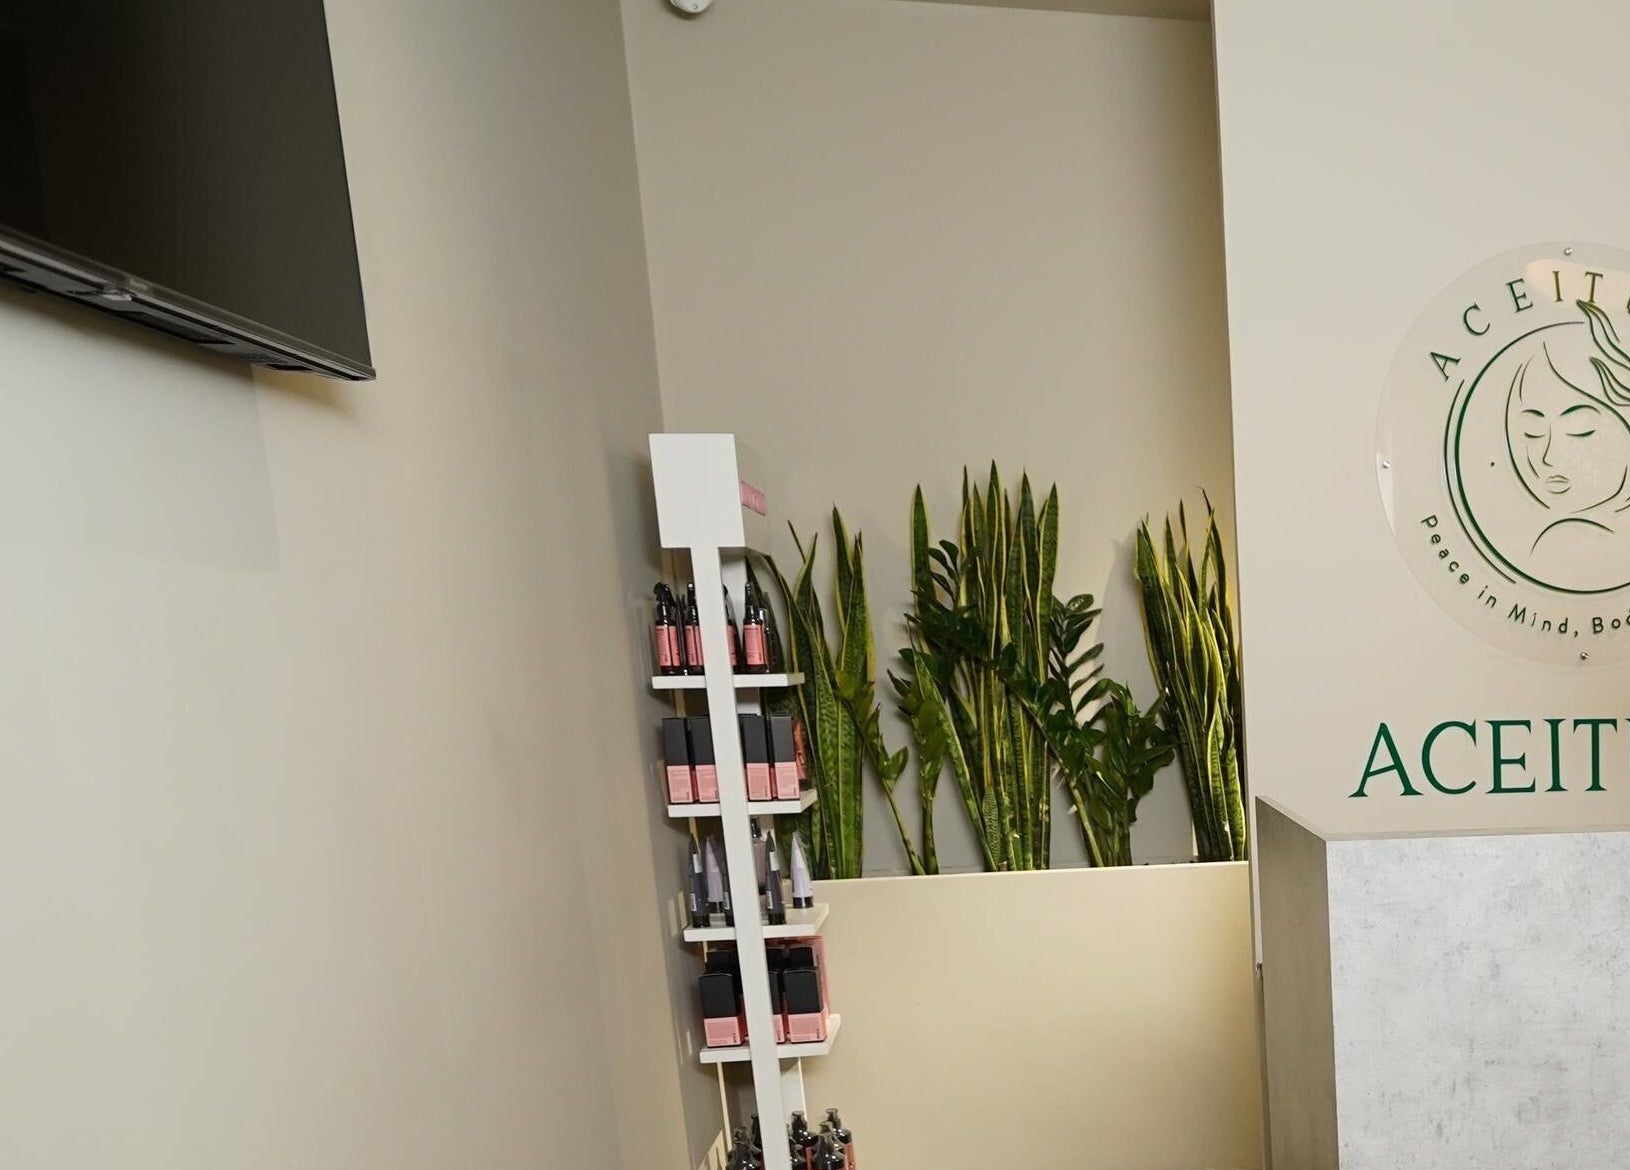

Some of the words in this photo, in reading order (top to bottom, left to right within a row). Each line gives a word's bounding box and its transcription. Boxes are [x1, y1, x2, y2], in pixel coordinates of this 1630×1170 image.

[1421, 513, 1470, 585] Peace
[1477, 585, 1497, 608] in
[1508, 603, 1579, 638] Mind,
